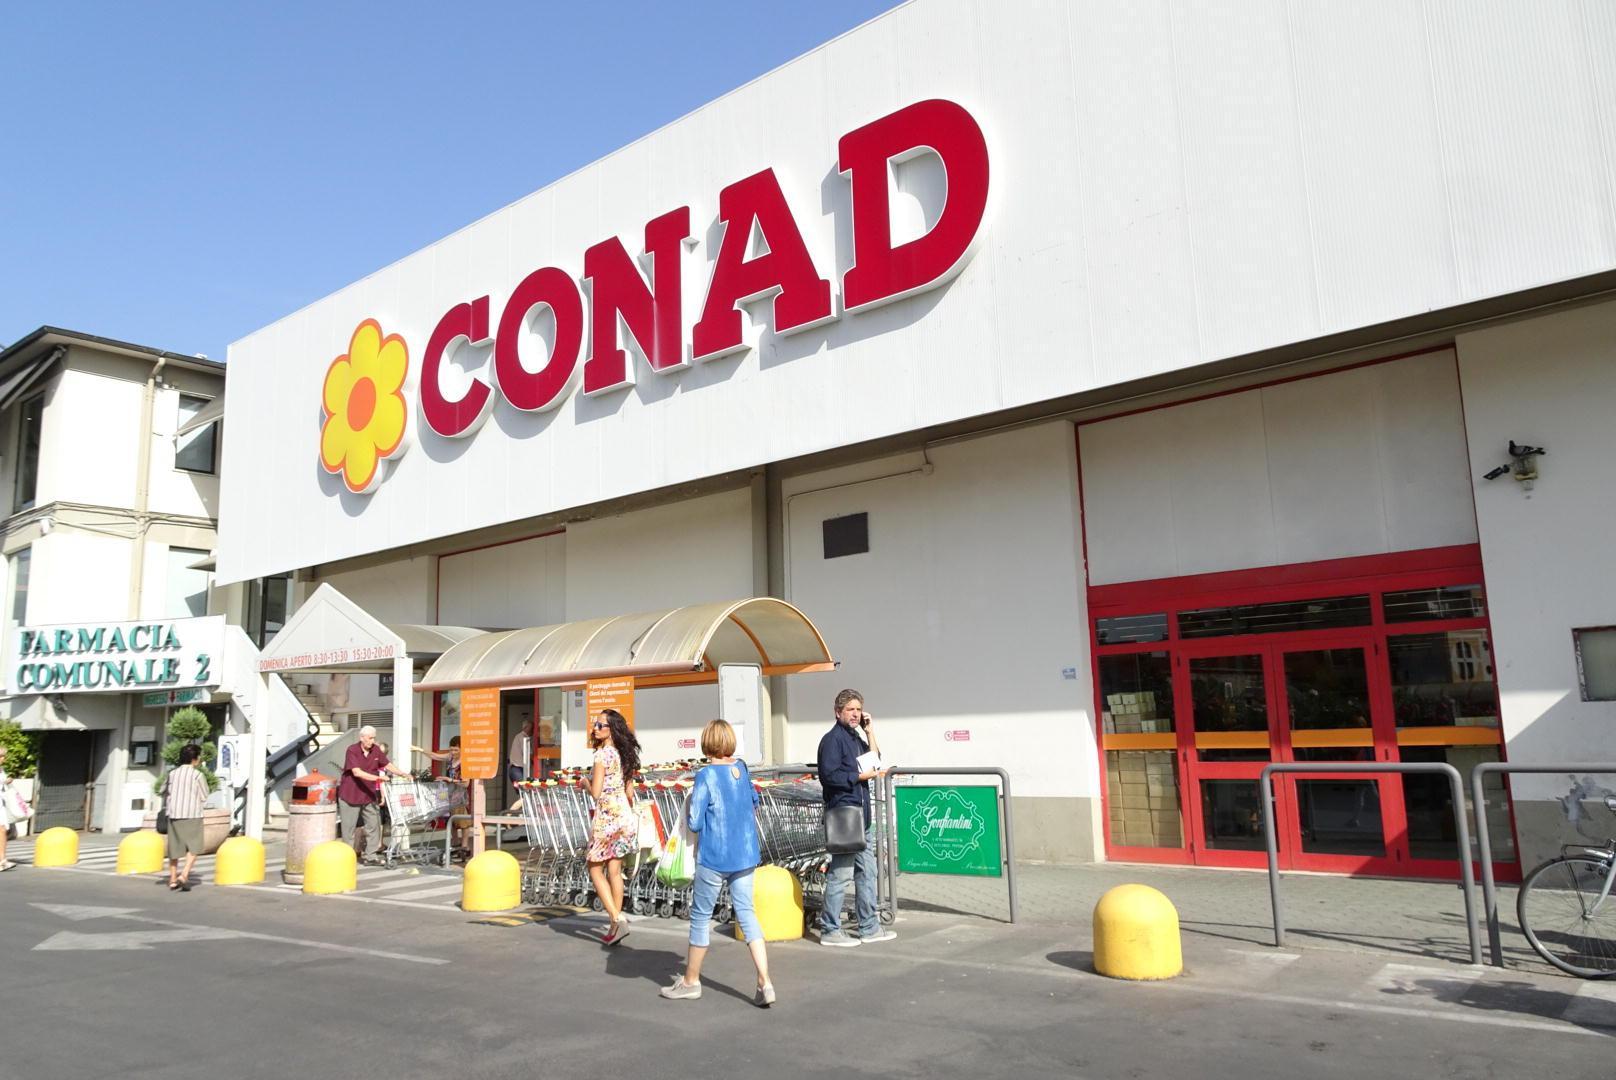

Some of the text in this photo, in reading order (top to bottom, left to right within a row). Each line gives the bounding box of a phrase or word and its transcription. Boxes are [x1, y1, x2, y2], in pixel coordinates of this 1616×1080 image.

[420, 98, 990, 438] CONAD
[20, 624, 181, 657] FARMACIA
[260, 645, 394, 670] DOMENICA APERTO 8:30-13:30 15:30-20:00
[17, 654, 210, 690] COMUNALE 2
